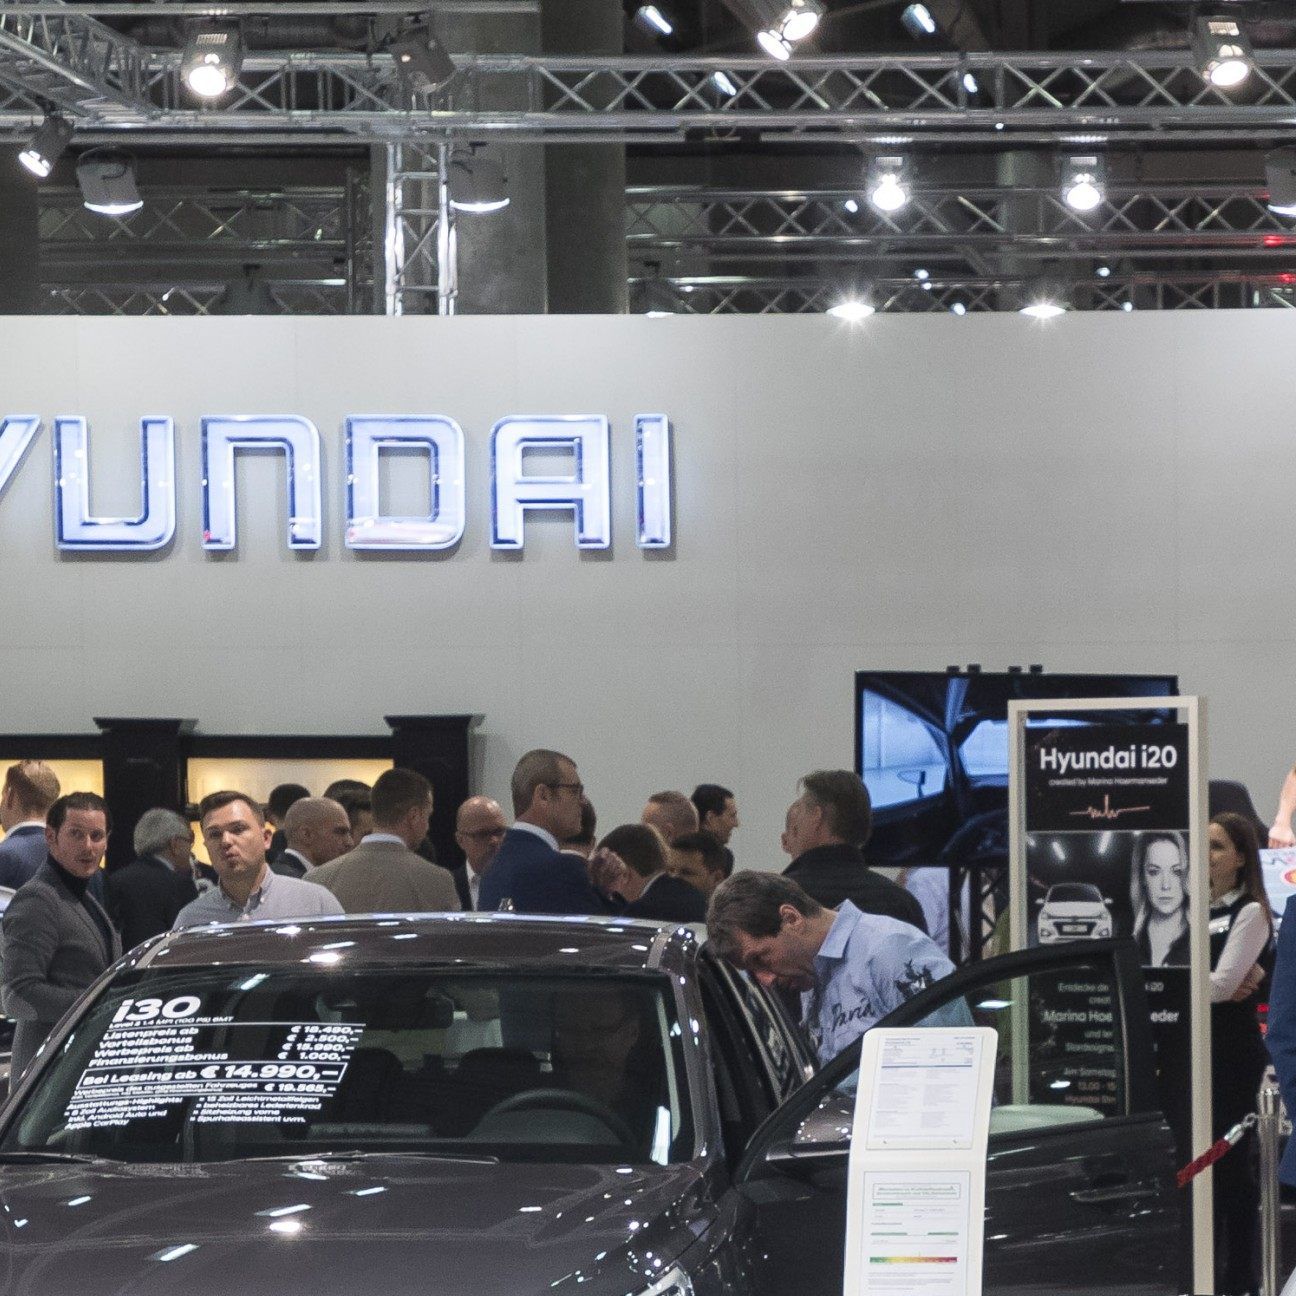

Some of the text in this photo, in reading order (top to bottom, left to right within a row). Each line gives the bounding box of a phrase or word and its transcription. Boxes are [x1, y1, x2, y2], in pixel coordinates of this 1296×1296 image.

[0, 414, 671, 551] UNDAI
[1040, 744, 1177, 774] Hyundai i20
[112, 996, 201, 1023] i30
[102, 1028, 177, 1041] Listenpreis
[179, 1027, 199, 1036] ab
[99, 1036, 193, 1049] Vorteilsbonus
[94, 1046, 172, 1058] Werbepreis
[173, 1044, 194, 1052] ab
[88, 1053, 228, 1067] Finanzierungsbonus
[82, 1074, 109, 1085] Bei
[110, 1071, 173, 1083] Leasing
[174, 1070, 197, 1079] ab
